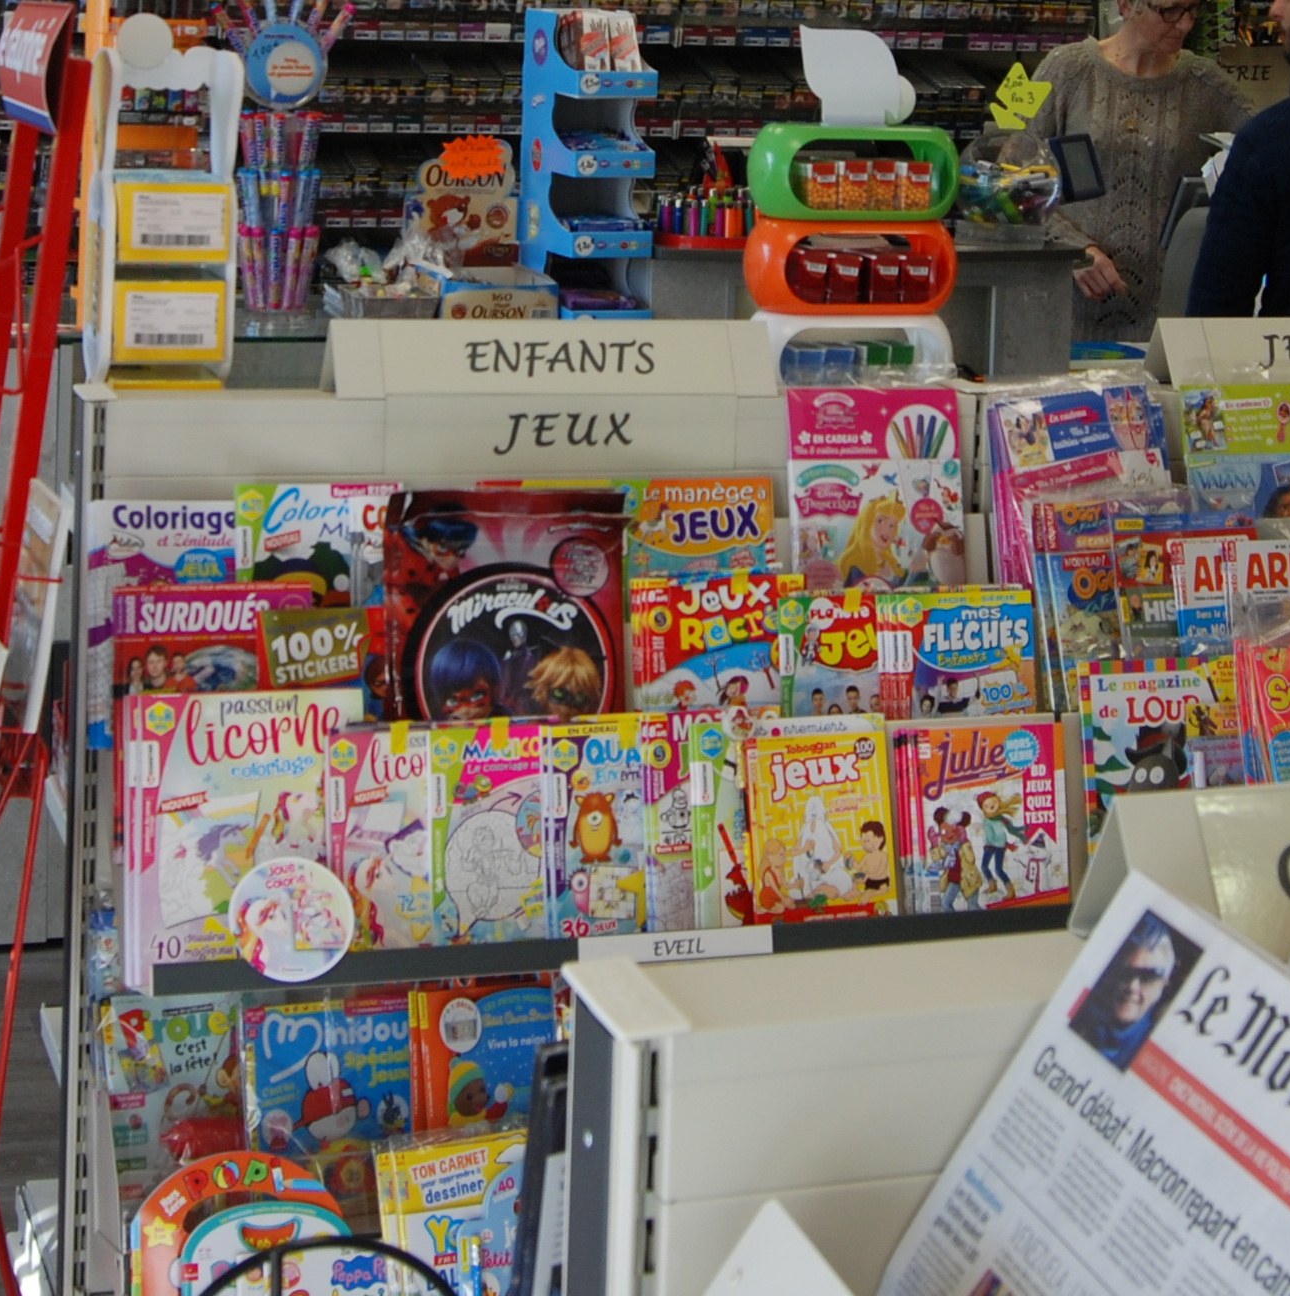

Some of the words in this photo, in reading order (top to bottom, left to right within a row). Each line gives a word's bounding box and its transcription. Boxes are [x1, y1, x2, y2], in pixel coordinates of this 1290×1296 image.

[470, 304, 526, 320] OURSON
[464, 339, 657, 377] ENFANTS
[1061, 408, 1088, 422] cadeau
[493, 411, 634, 456] JEUX
[813, 434, 824, 443] EN
[825, 434, 859, 443] CADEAU
[643, 488, 659, 502] Le
[664, 482, 753, 503] manège
[112, 504, 235, 534] Coloriage
[670, 503, 761, 545] JEUX
[173, 534, 234, 548] Zénitude
[175, 565, 223, 578] JEUX
[961, 606, 1001, 620] mes
[1143, 600, 1176, 623] HIS
[272, 622, 361, 664] 100%
[923, 618, 1029, 654] FLÉCHÉS
[275, 654, 359, 685] STICKERS
[1098, 678, 1118, 693] Le
[1122, 675, 1201, 693] magazine
[220, 695, 300, 726] passion
[1099, 705, 1118, 719] de
[186, 700, 340, 767] licorne
[586, 725, 619, 735] CADEAU
[783, 721, 848, 735] premiers
[785, 740, 836, 755] Toboggan
[855, 742, 873, 754] 100
[231, 756, 315, 778] coloriage
[924, 731, 1007, 801] Julie
[1031, 764, 1047, 778] BD
[771, 752, 860, 803] jeux
[1026, 780, 1053, 793] JEUX
[1026, 795, 1052, 809] QUIZ
[1026, 810, 1056, 825] TESTS
[398, 895, 416, 912] 72
[561, 919, 590, 937] 36
[150, 934, 181, 960] 40
[653, 937, 706, 956] EVEIL
[1175, 966, 1232, 1038] Le
[175, 1040, 207, 1057] C'est
[411, 1163, 437, 1180] TON
[439, 1148, 487, 1177] CARNET
[1032, 1046, 1092, 1111] Grand
[1124, 1127, 1197, 1201] Macron
[1182, 1177, 1233, 1256] repart
[1227, 1228, 1259, 1268] en
[425, 1178, 485, 1204] dessiner
[495, 1176, 515, 1193] 40
[480, 1249, 513, 1269] Petit
